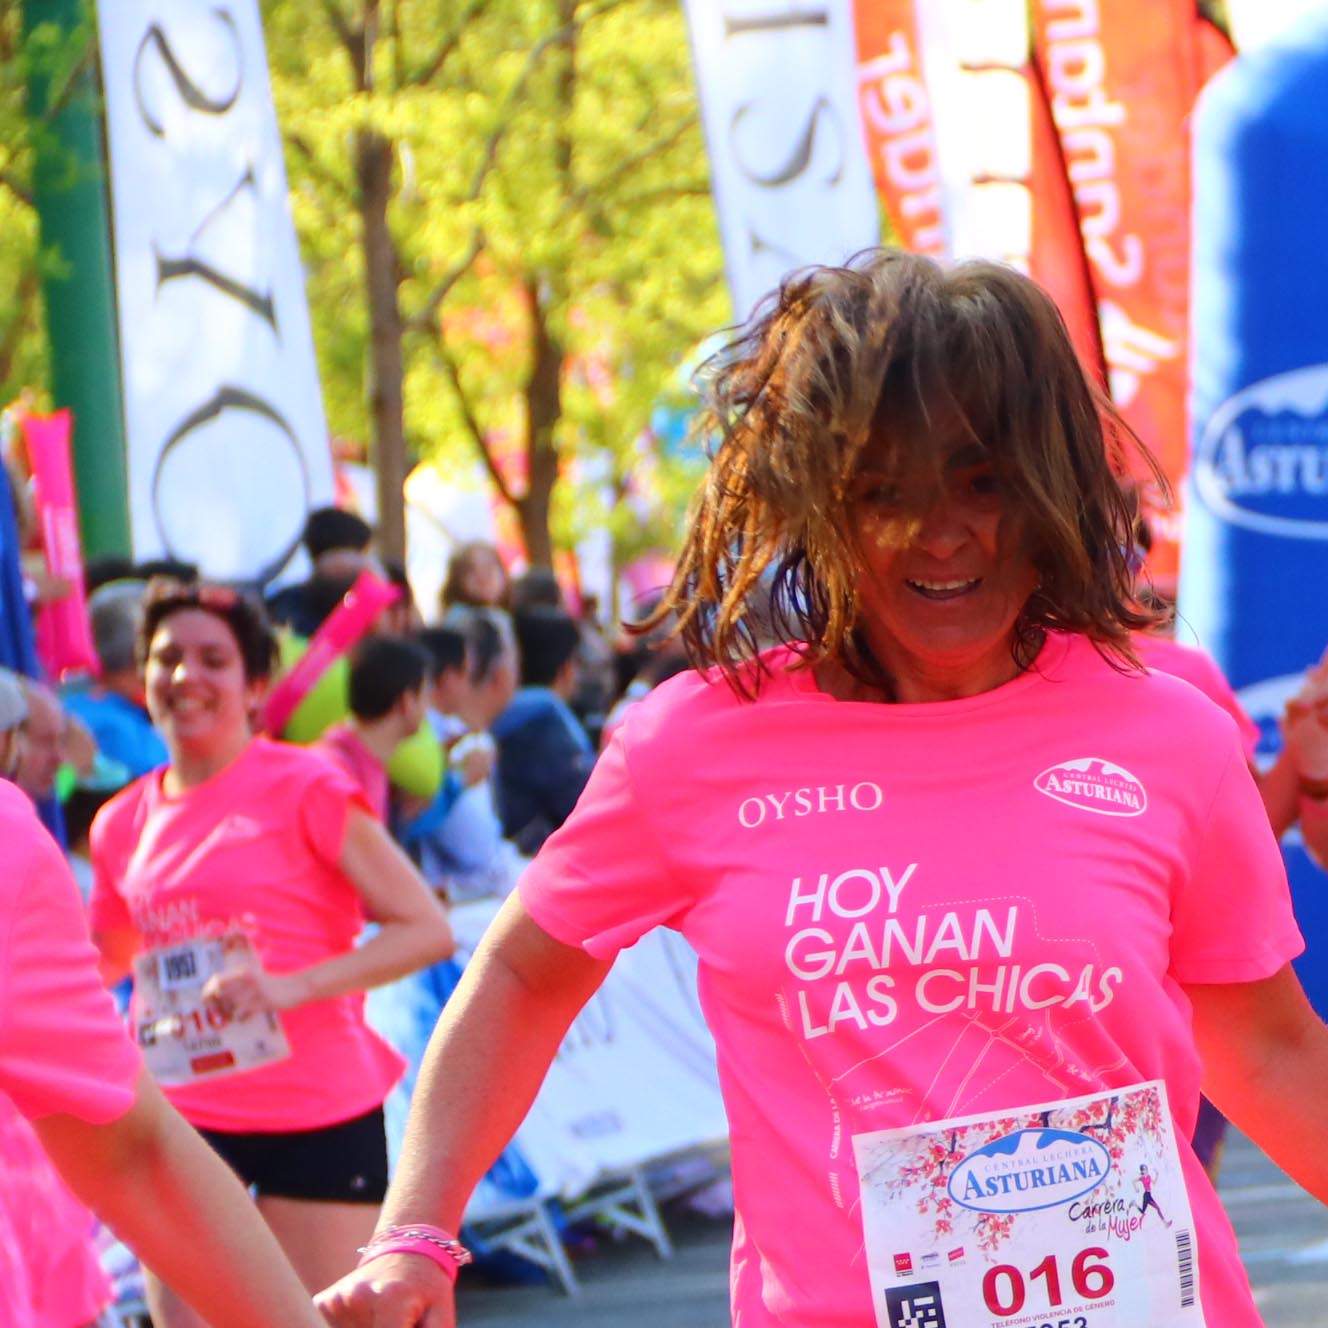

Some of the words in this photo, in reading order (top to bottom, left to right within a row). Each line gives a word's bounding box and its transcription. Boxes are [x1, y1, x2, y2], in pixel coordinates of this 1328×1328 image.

[738, 782, 884, 829] OYSHO
[1045, 773, 1141, 810] ASTURIANA
[784, 863, 918, 927] HOY
[785, 906, 1017, 981] GANAN
[798, 974, 897, 1039] LAS
[914, 963, 1123, 1014] CHICAS
[963, 1157, 1102, 1200] ASTURIANA
[1069, 1199, 1125, 1221] Carrera
[1086, 1219, 1096, 1233] de
[1107, 1209, 1145, 1241] Mujer
[982, 1246, 1115, 1317] 016
